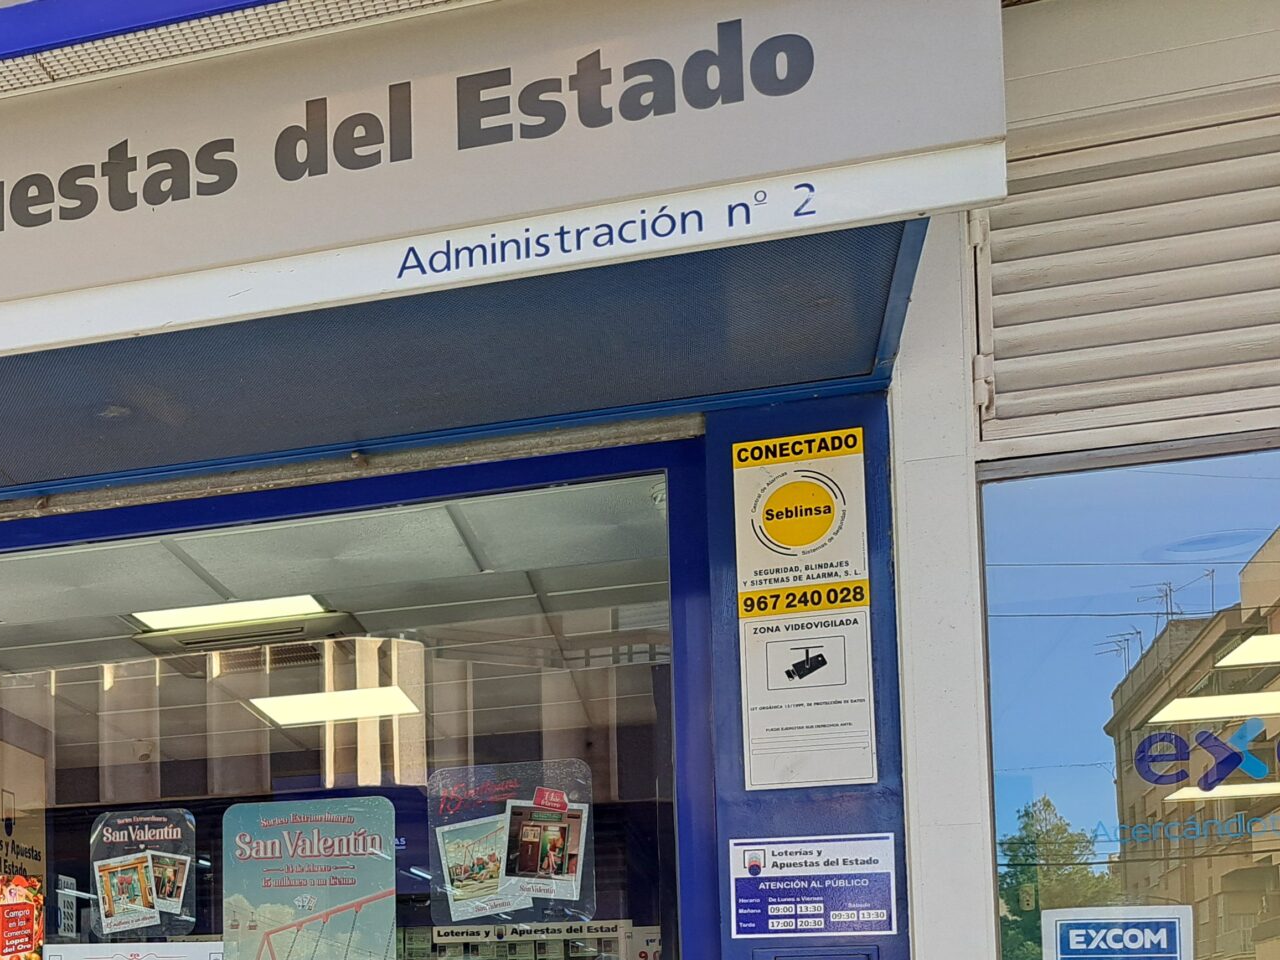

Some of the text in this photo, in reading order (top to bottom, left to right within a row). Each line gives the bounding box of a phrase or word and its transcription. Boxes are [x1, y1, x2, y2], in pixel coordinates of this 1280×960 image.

[274, 81, 413, 182] del
[457, 18, 815, 150] Estado
[396, 206, 704, 279] Administración
[793, 183, 817, 217] 2
[737, 433, 858, 463] CONECTADO
[765, 505, 832, 521] Seblinsa
[753, 560, 849, 577] SEGURIDAD, BLINDAJES
[750, 576, 791, 587] SISTEMAS
[806, 571, 842, 581] ALARMA,
[743, 585, 865, 613] 967 240 028
[753, 618, 859, 635] ZONA VIDEOVIGILADA
[1134, 717, 1280, 792] ex
[260, 812, 355, 827] Sorteo Extraordinario
[103, 824, 182, 843] San Valentín
[1093, 814, 1280, 843] Acercándo
[11, 840, 41, 861] Apuestas
[235, 832, 282, 860] San
[282, 828, 384, 858] Valentín
[771, 849, 823, 857] Loterías y
[4, 860, 27, 876] Estado
[771, 857, 880, 870] Apuestas del Estado
[262, 878, 272, 888] 15
[272, 877, 308, 887] millones
[759, 877, 869, 890] ATENCIÓN AL PÚBLICO
[770, 905, 822, 913] 09:00 13:30
[770, 911, 885, 928] 17:00 20:30 09:30 13:30
[437, 925, 619, 938] Loterías y Apuestas del Estad
[1069, 928, 1167, 950] EXCOM
